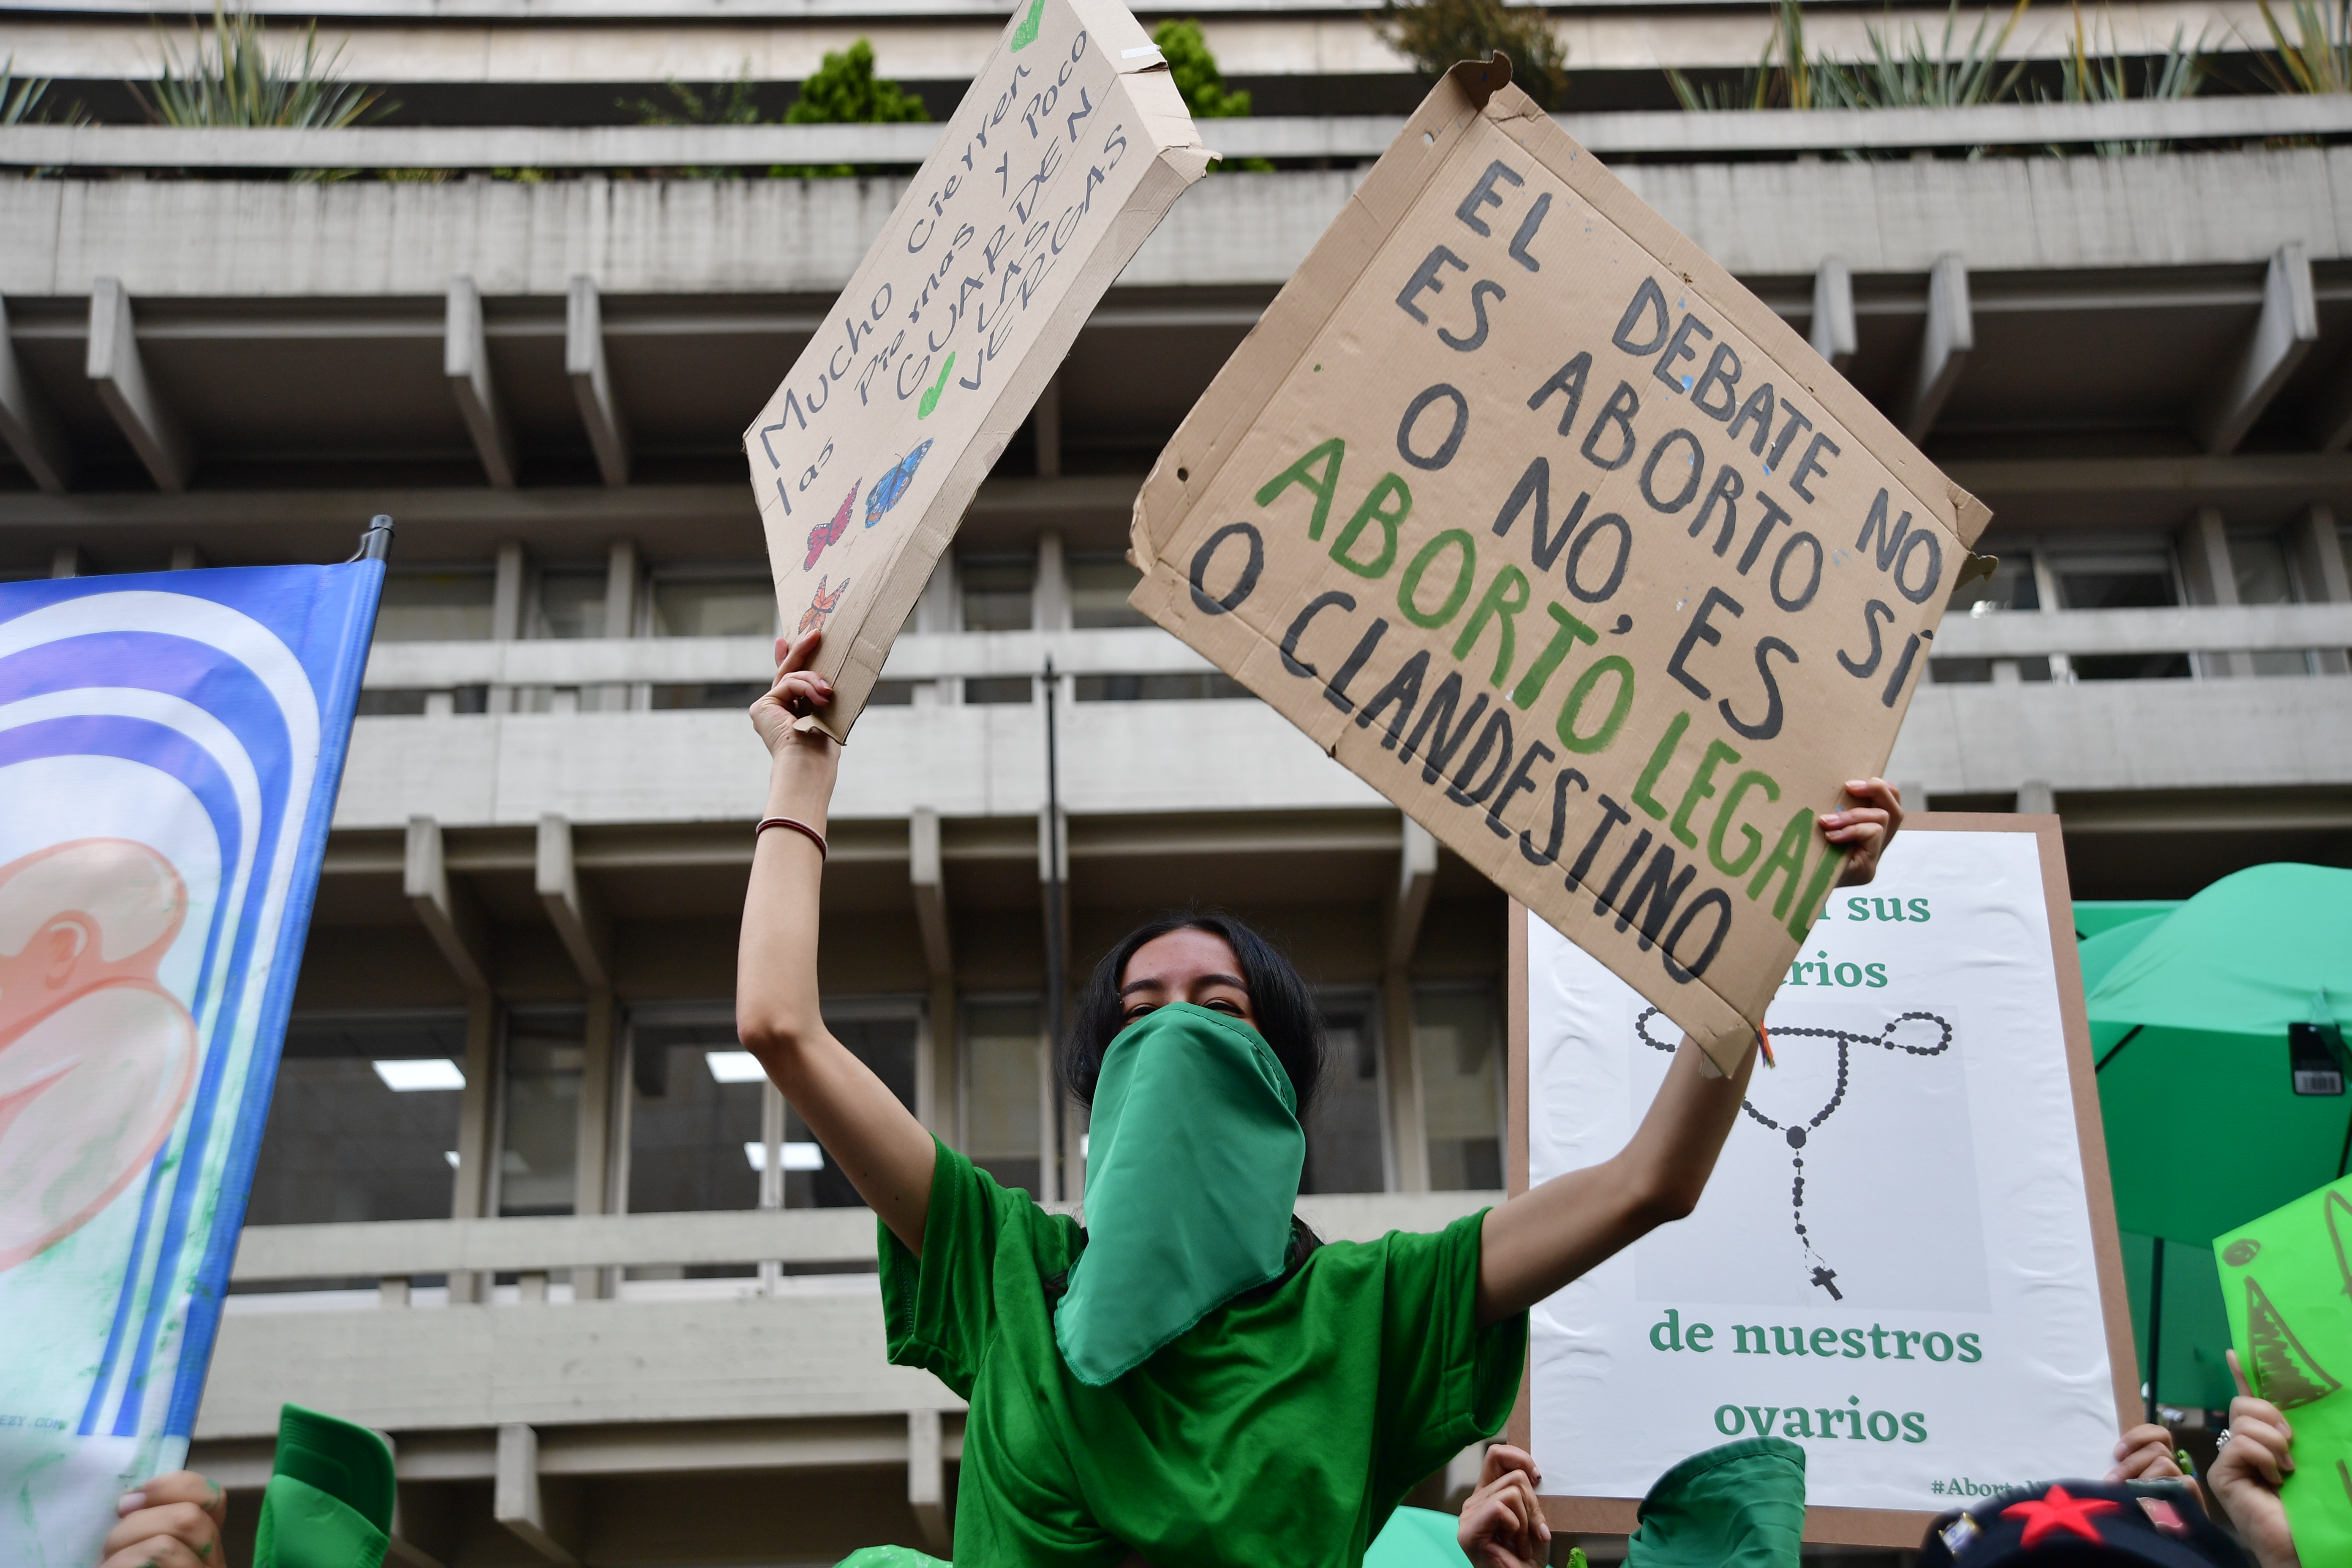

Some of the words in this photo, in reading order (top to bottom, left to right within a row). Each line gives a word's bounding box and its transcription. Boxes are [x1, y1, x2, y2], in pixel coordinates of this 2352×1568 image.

[760, 282, 892, 470] Mucho
[907, 64, 1032, 253] Cierren
[776, 436, 834, 516] las
[854, 222, 975, 406] Piernas
[896, 87, 1092, 400] GUARDEN
[958, 123, 1127, 390] VERGAS
[978, 220, 1050, 333] LAS
[1455, 160, 1552, 272] EL
[1612, 275, 1841, 504] DEBATE
[1855, 487, 1942, 605] NO
[1395, 244, 1506, 352] ES
[1527, 350, 1824, 612] ABORTO
[1396, 383, 1469, 471] O
[1492, 456, 1633, 635] NO,
[1666, 585, 1799, 740] ES
[1254, 437, 1635, 754] ABORTO
[1190, 522, 1264, 615] O
[1280, 591, 1732, 985] CLANDESTINO
[1780, 950, 1888, 988] rios
[1847, 897, 1930, 922] sus
[1650, 1308, 1714, 1352] de
[1731, 1323, 1982, 1363] nuestros
[1714, 1394, 1927, 1443] ovarios
